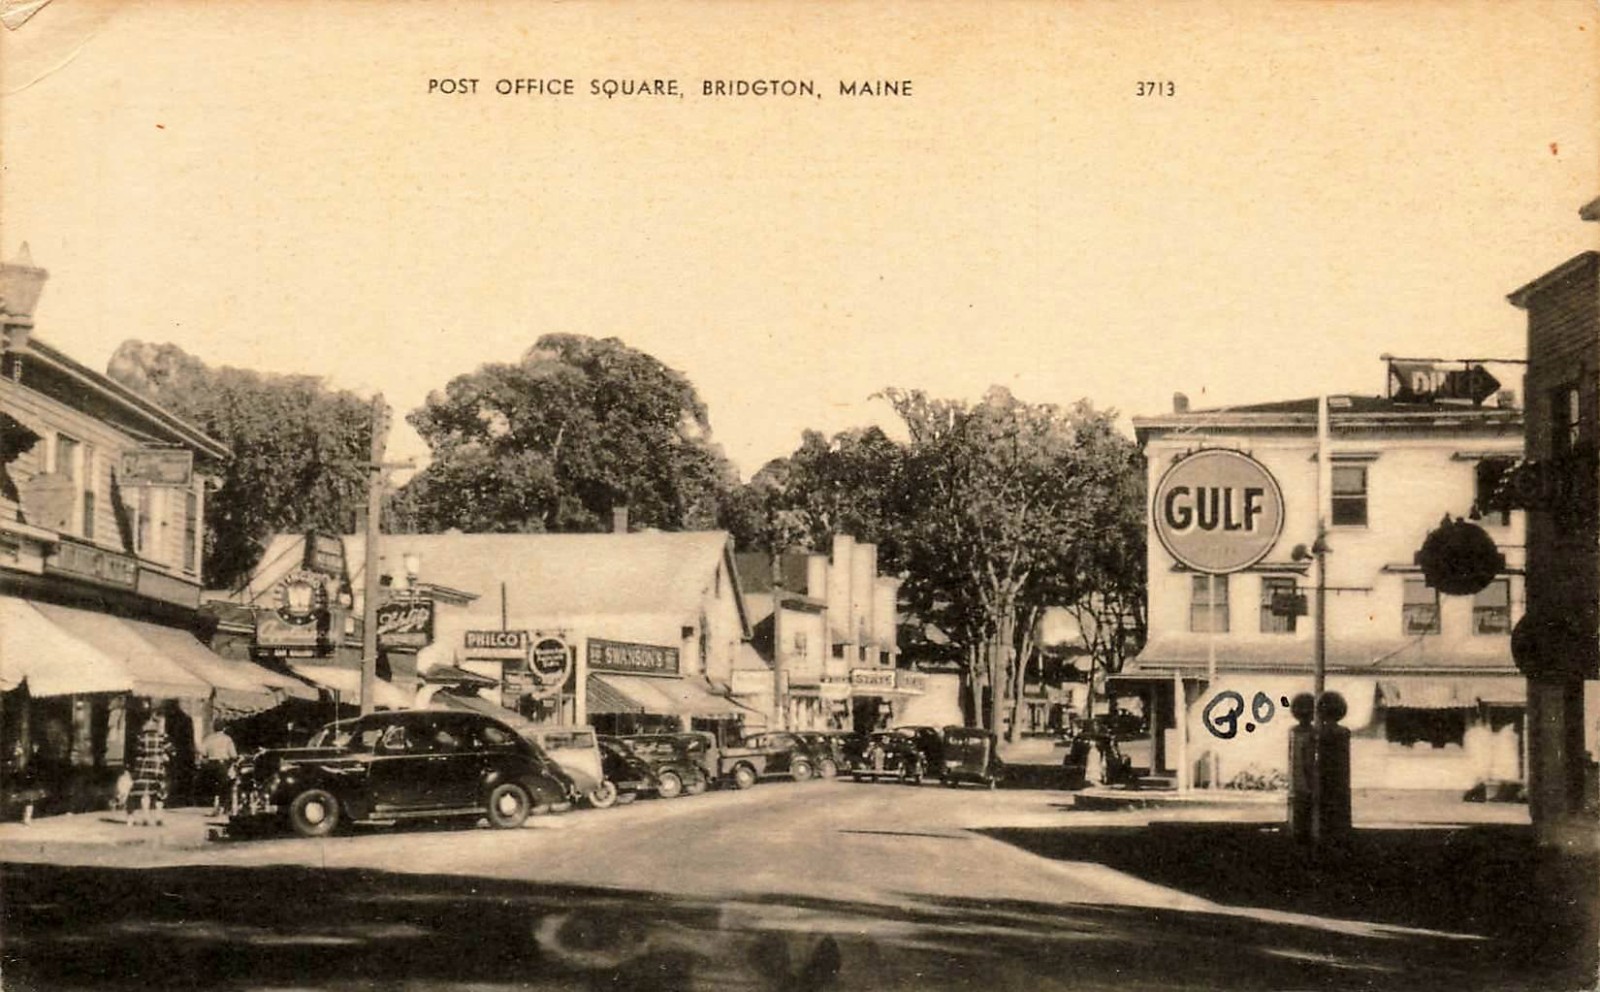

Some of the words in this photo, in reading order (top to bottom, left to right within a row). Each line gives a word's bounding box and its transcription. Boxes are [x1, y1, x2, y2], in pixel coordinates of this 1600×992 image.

[1164, 486, 1265, 532] GULF
[466, 632, 519, 647] PHILCO
[604, 646, 664, 668] SWANSON'S
